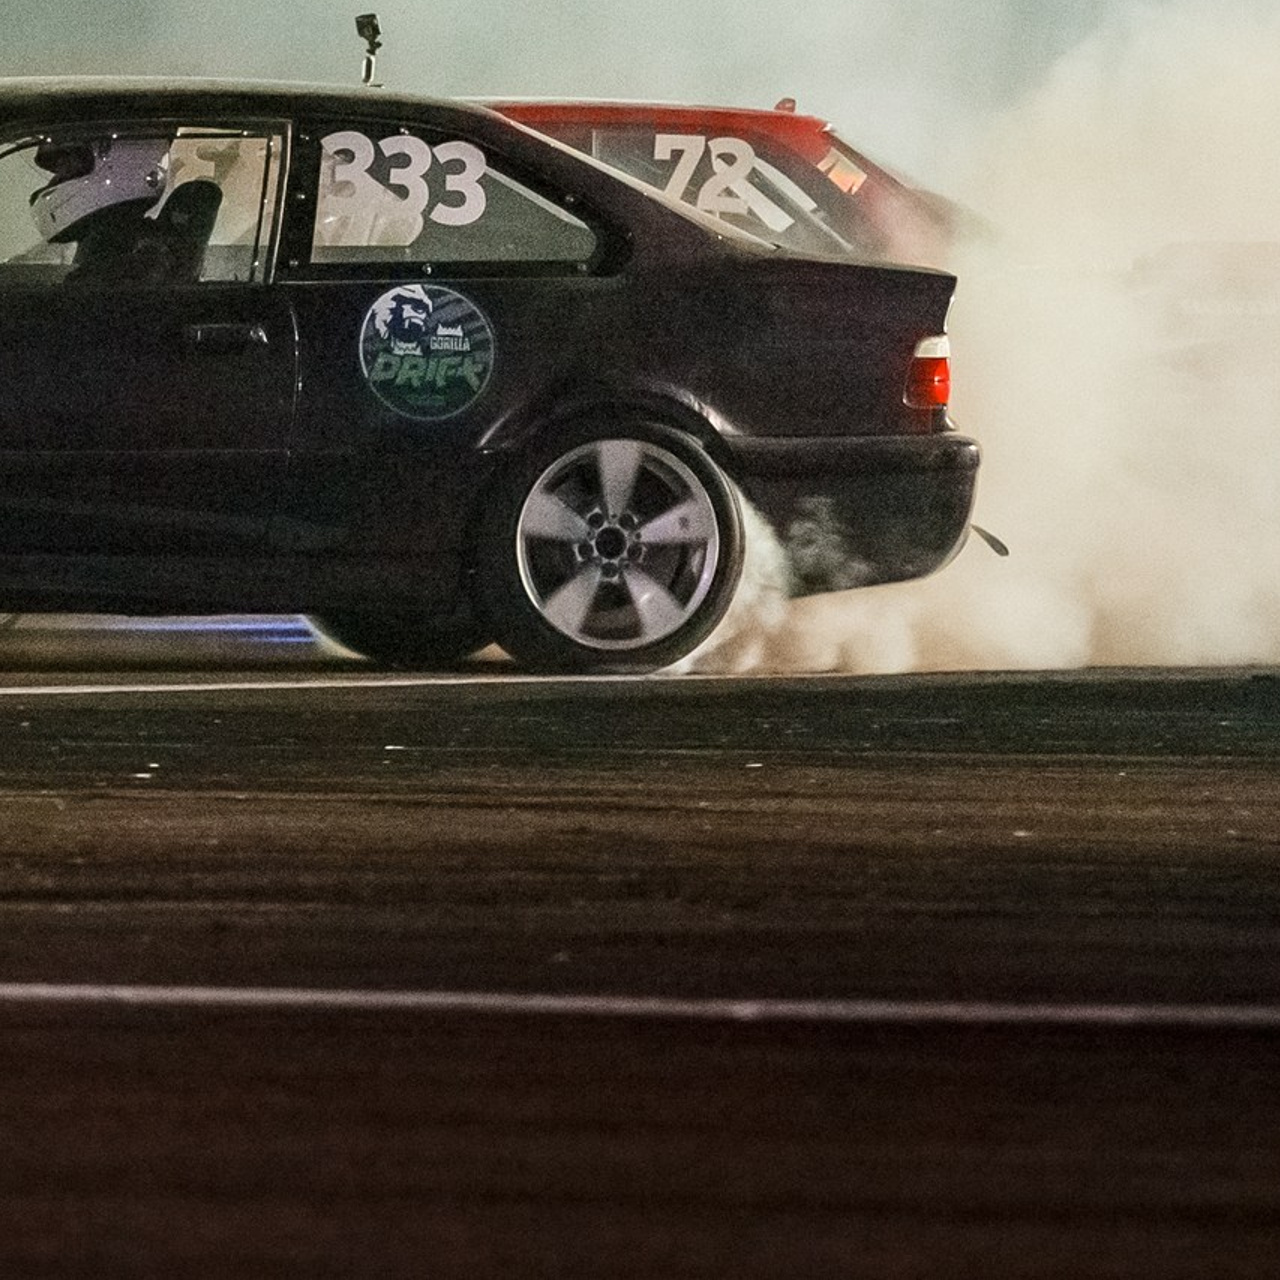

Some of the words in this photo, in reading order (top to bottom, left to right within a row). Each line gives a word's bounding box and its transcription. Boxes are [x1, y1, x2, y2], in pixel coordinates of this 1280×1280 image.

[320, 131, 486, 226] 333
[429, 337, 471, 351] GORILLA
[370, 352, 484, 392] DRIFT
